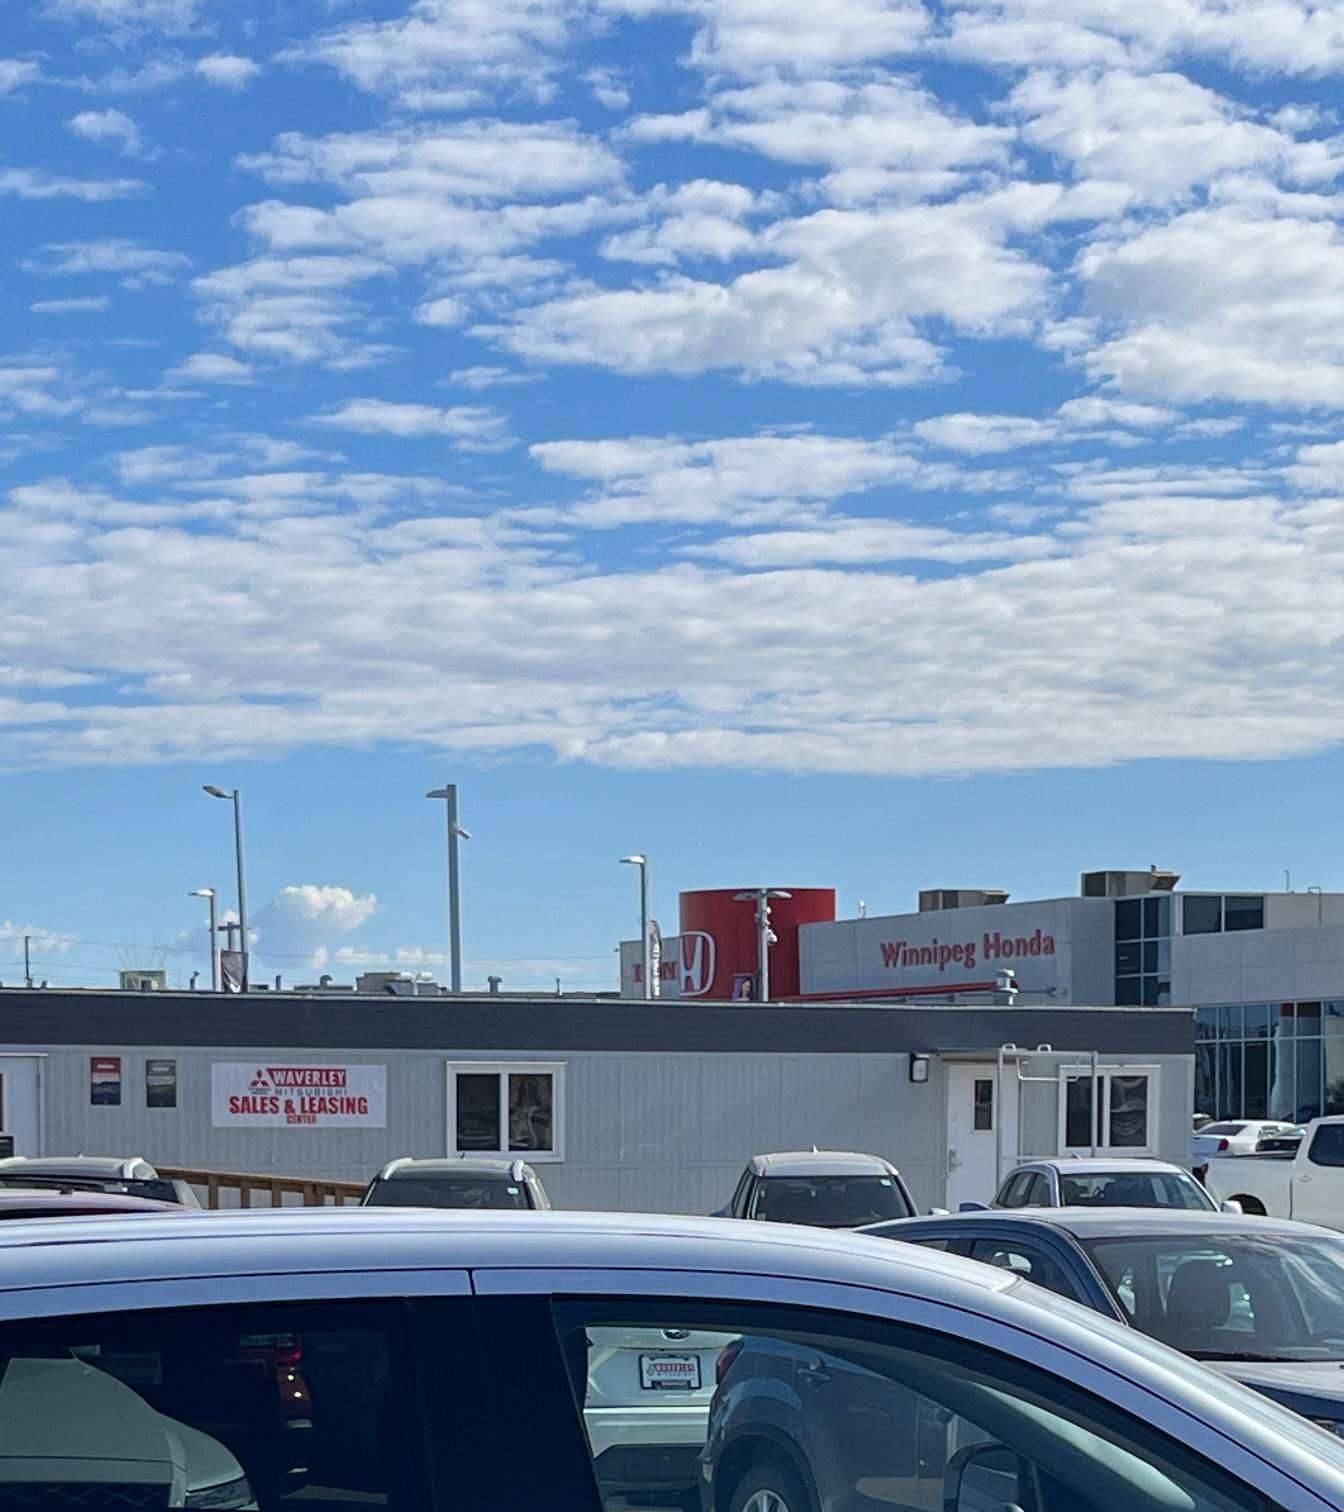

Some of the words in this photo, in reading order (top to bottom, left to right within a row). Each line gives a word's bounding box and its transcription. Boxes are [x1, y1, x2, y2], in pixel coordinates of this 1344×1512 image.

[880, 938, 976, 971] Winnipeg
[983, 928, 1055, 959] Honda
[273, 1070, 345, 1086] WAVERLEY
[274, 1088, 348, 1096] MITSUBISHI
[229, 1096, 279, 1114] SALES
[284, 1099, 296, 1114] &
[301, 1096, 368, 1114] LEASING
